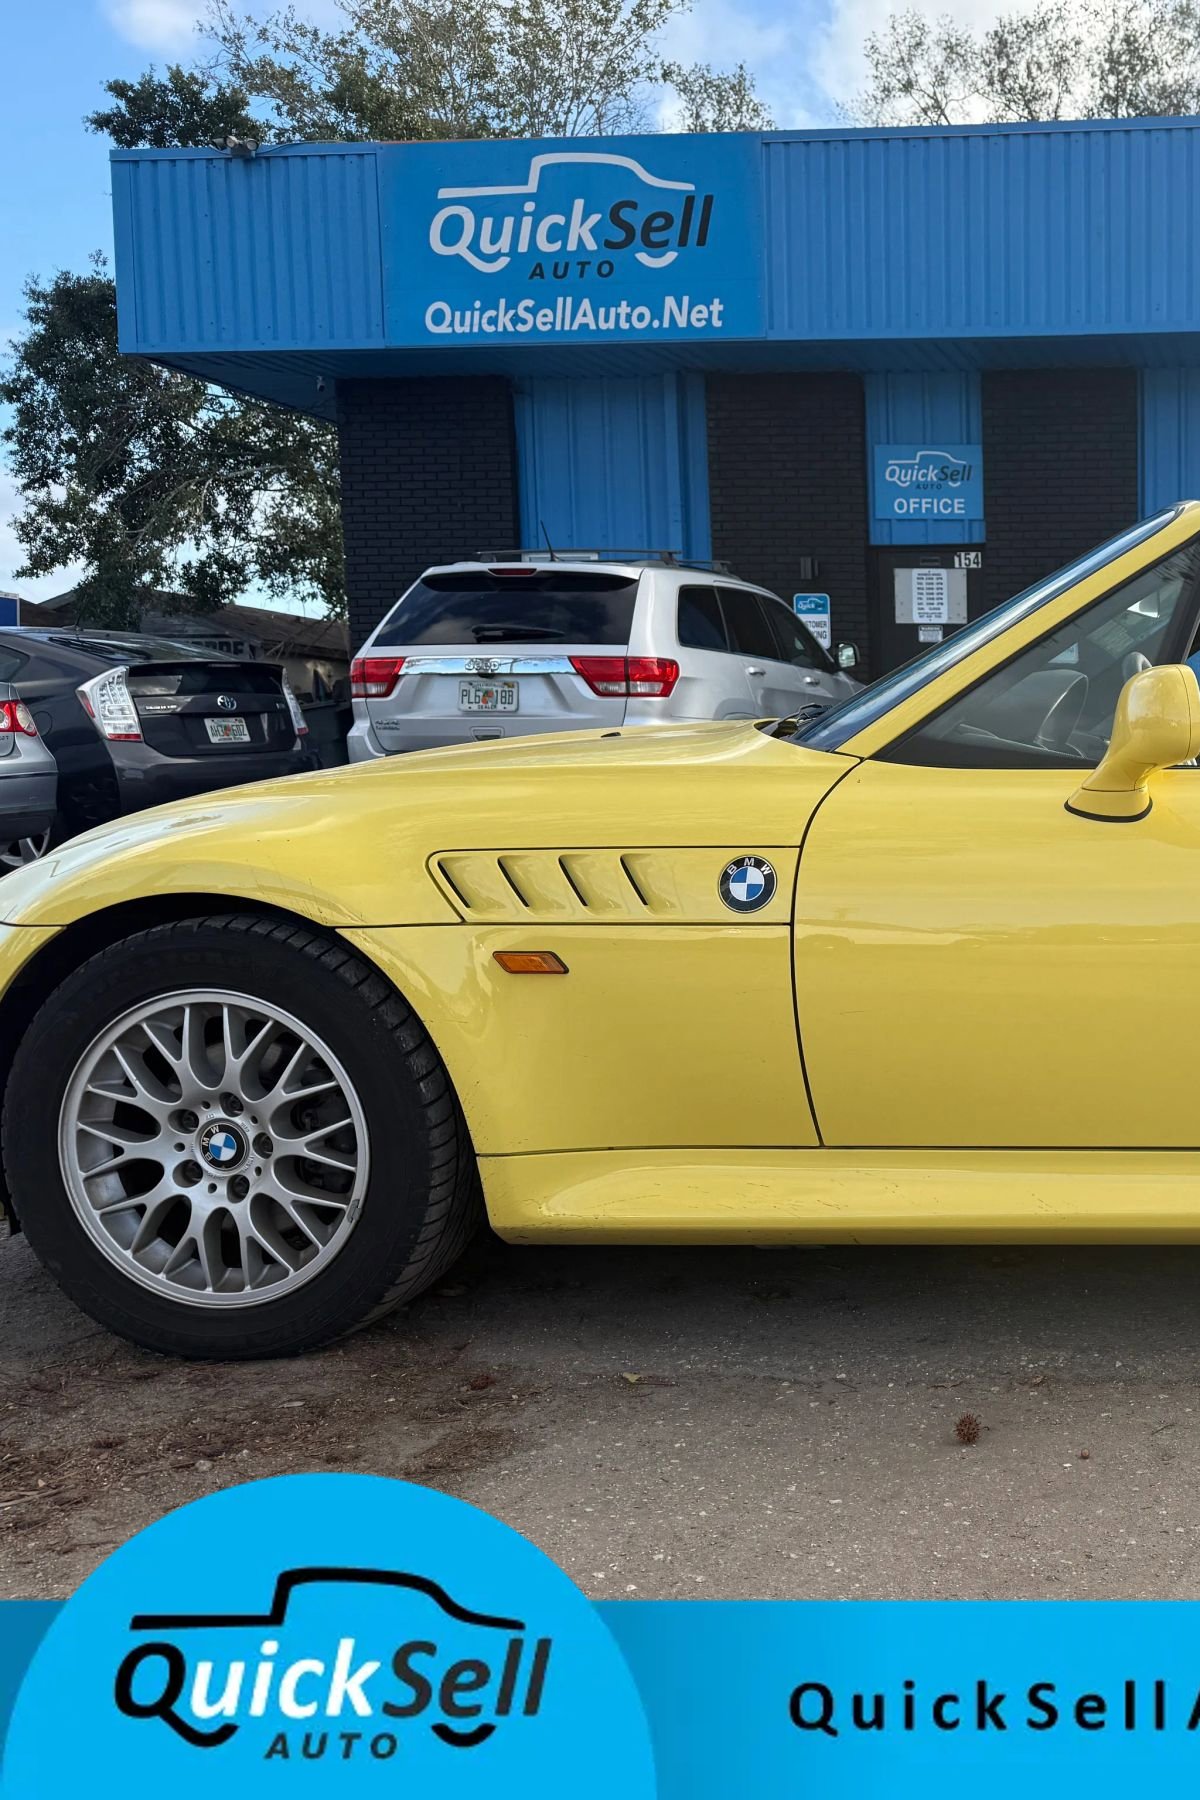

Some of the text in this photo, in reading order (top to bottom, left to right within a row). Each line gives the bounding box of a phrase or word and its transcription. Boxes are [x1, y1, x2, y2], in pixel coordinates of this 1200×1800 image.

[428, 194, 715, 273] QuickSell
[528, 260, 615, 280] AUTO
[424, 295, 724, 334] QuickSellAuto.Net
[885, 464, 972, 488] QuickSell
[894, 498, 966, 514] OFFICE
[954, 552, 980, 568] 154
[465, 658, 500, 672] Jeep
[727, 857, 772, 875] BMW
[202, 1125, 220, 1161] BMW
